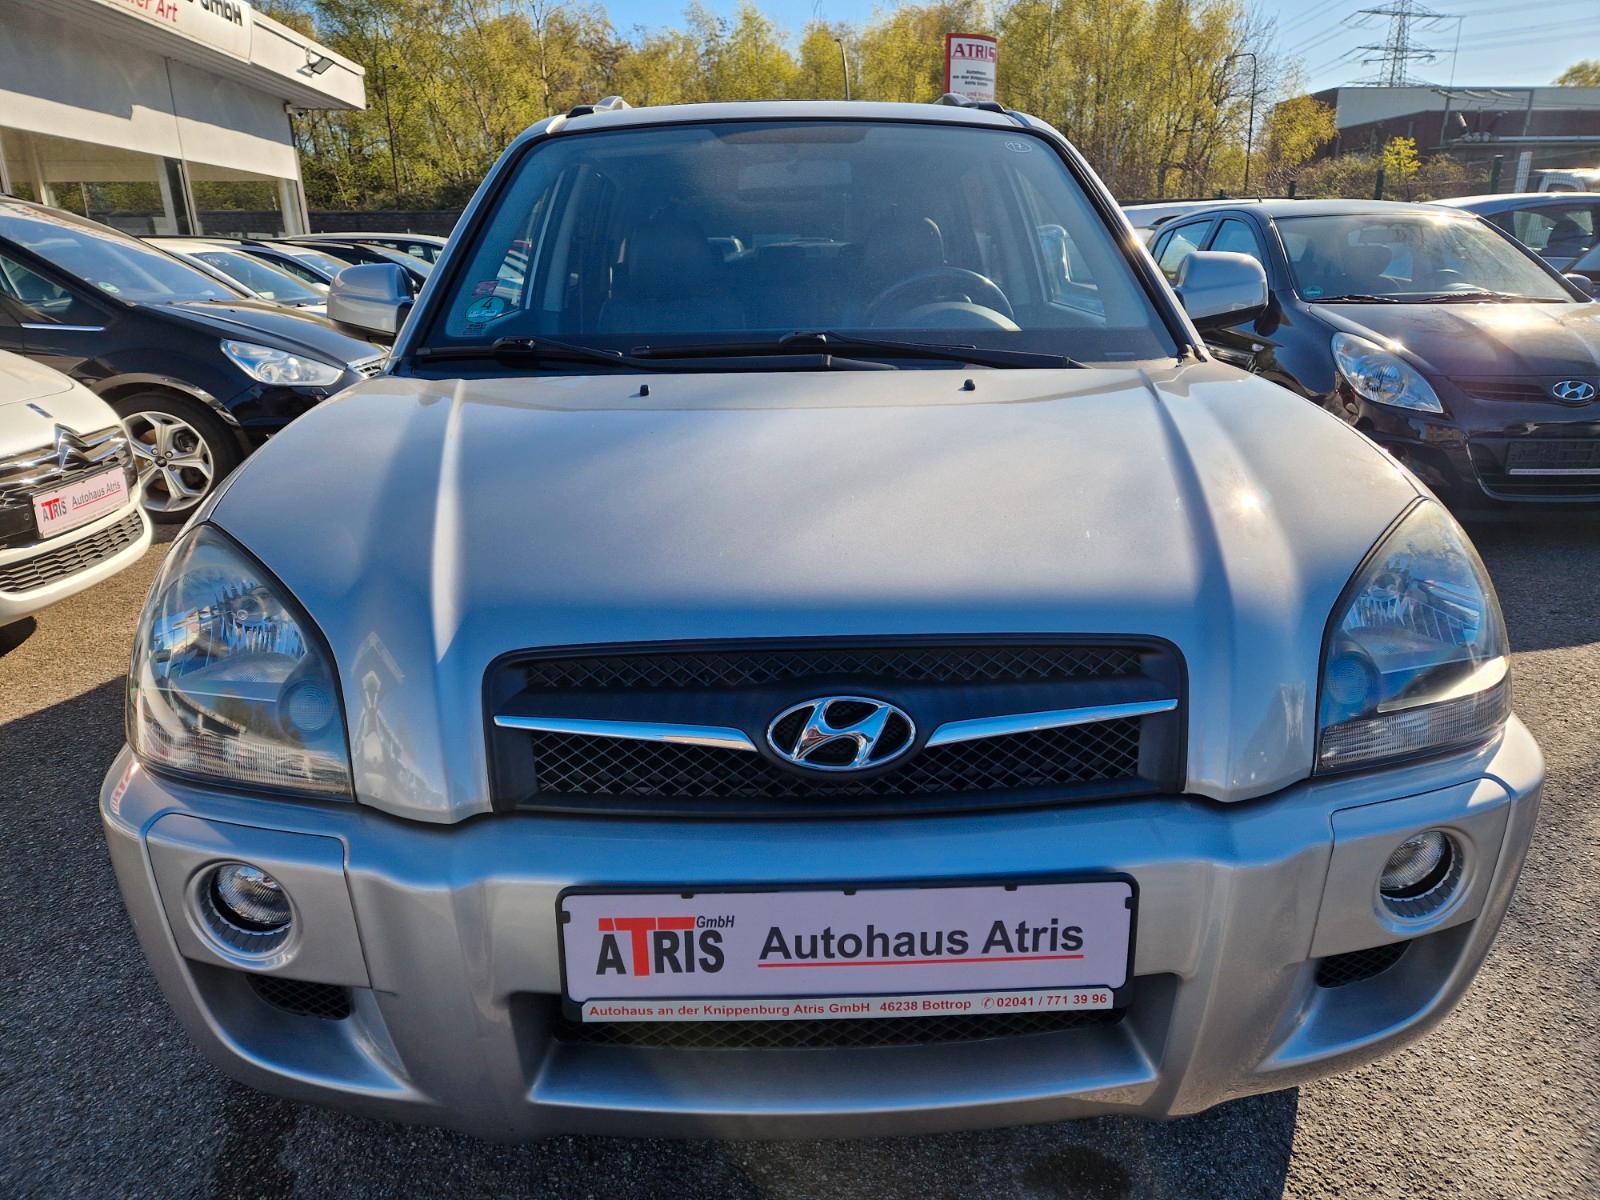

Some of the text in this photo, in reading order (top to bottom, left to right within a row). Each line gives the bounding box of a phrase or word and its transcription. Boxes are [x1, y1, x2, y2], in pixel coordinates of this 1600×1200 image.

[156, 0, 178, 22] Art
[72, 481, 121, 507] Autohaus Atris
[41, 498, 68, 522] ATRIS
[696, 915, 735, 929] GmbH
[596, 917, 725, 976] ATRIS
[759, 918, 1084, 960] Autohaus Atris
[589, 1005, 653, 1016] Autohaus
[658, 1007, 673, 1015] an
[678, 1005, 699, 1015] der
[703, 1004, 790, 1017] Knippenburg
[794, 1003, 824, 1014] Atris
[829, 1002, 870, 1013] GmbH
[879, 1001, 918, 1011] 46238
[922, 999, 971, 1013] Bottrop
[997, 996, 1034, 1007] 02041
[1047, 995, 1068, 1005] 771
[1073, 994, 1088, 1004] 39
[1092, 993, 1107, 1003] 96
